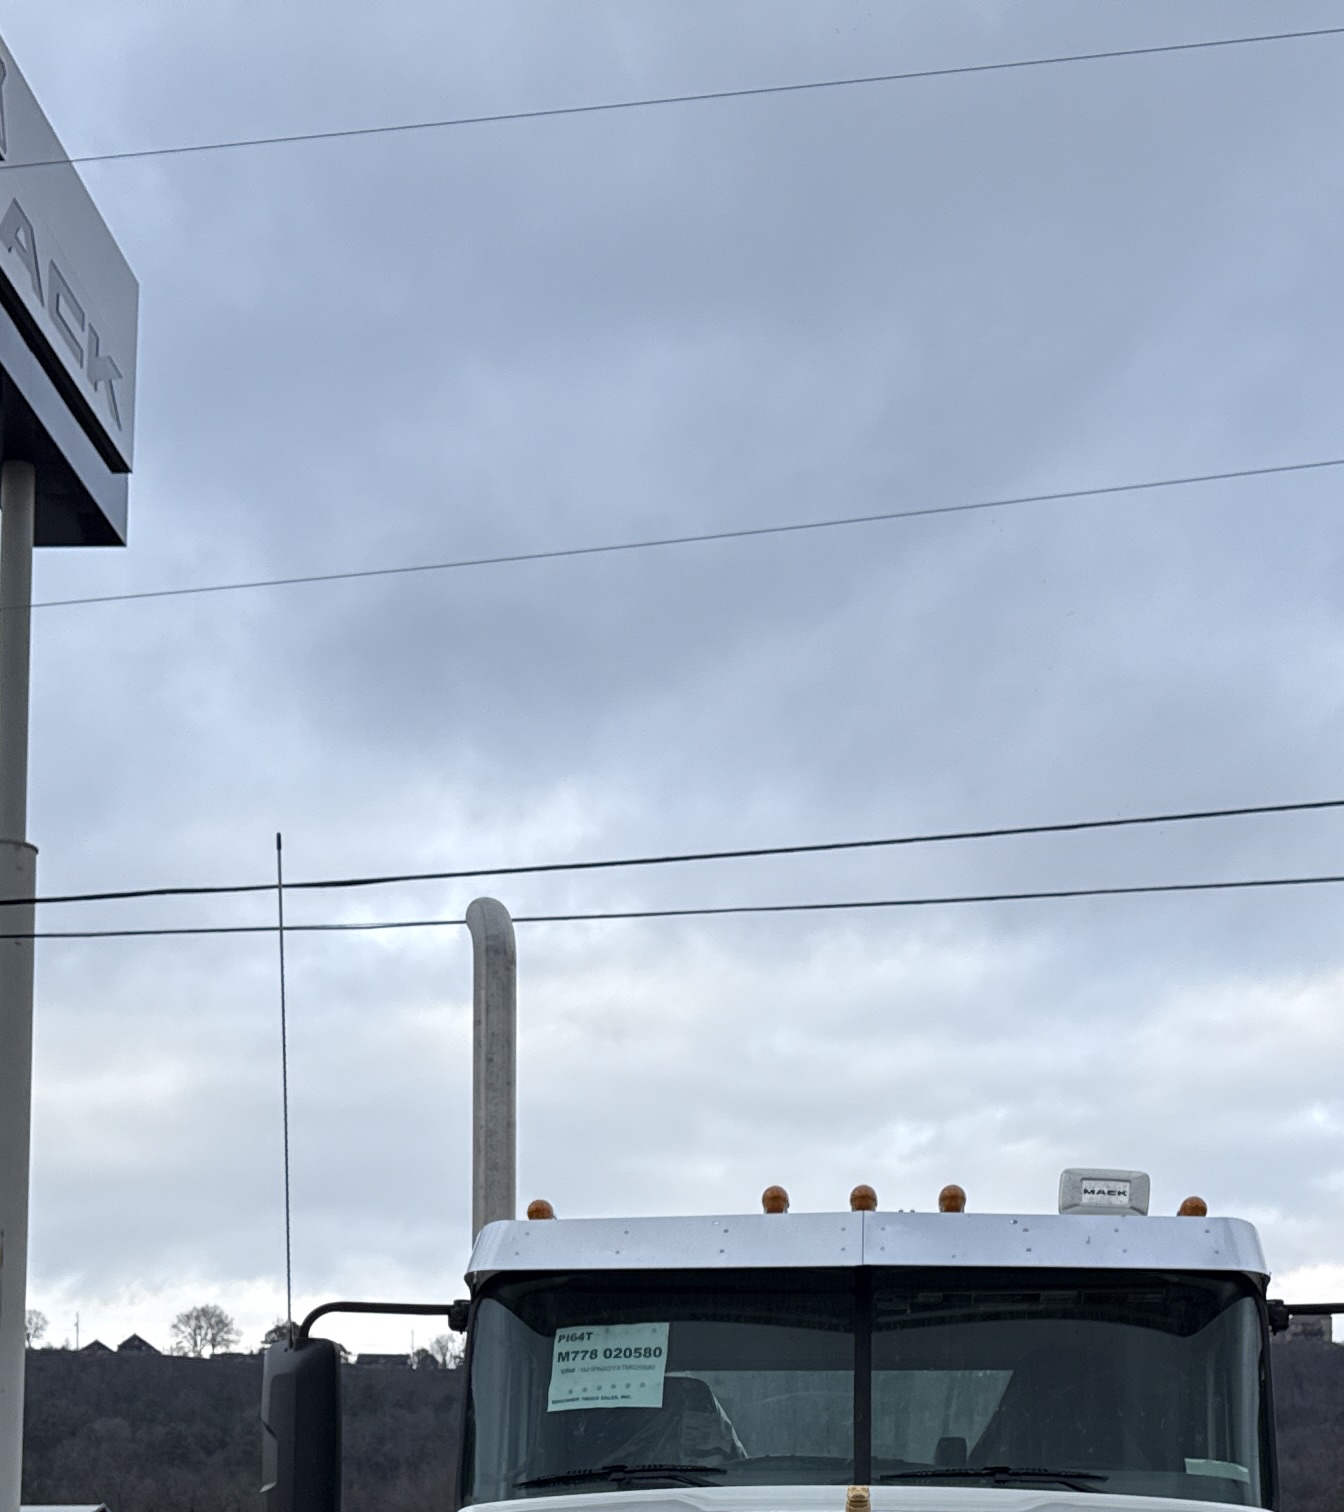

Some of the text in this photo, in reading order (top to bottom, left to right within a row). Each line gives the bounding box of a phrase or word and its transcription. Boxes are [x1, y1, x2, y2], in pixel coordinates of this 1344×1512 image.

[1083, 1188, 1128, 1197] MACK
[557, 1346, 663, 1363] M778 020580
